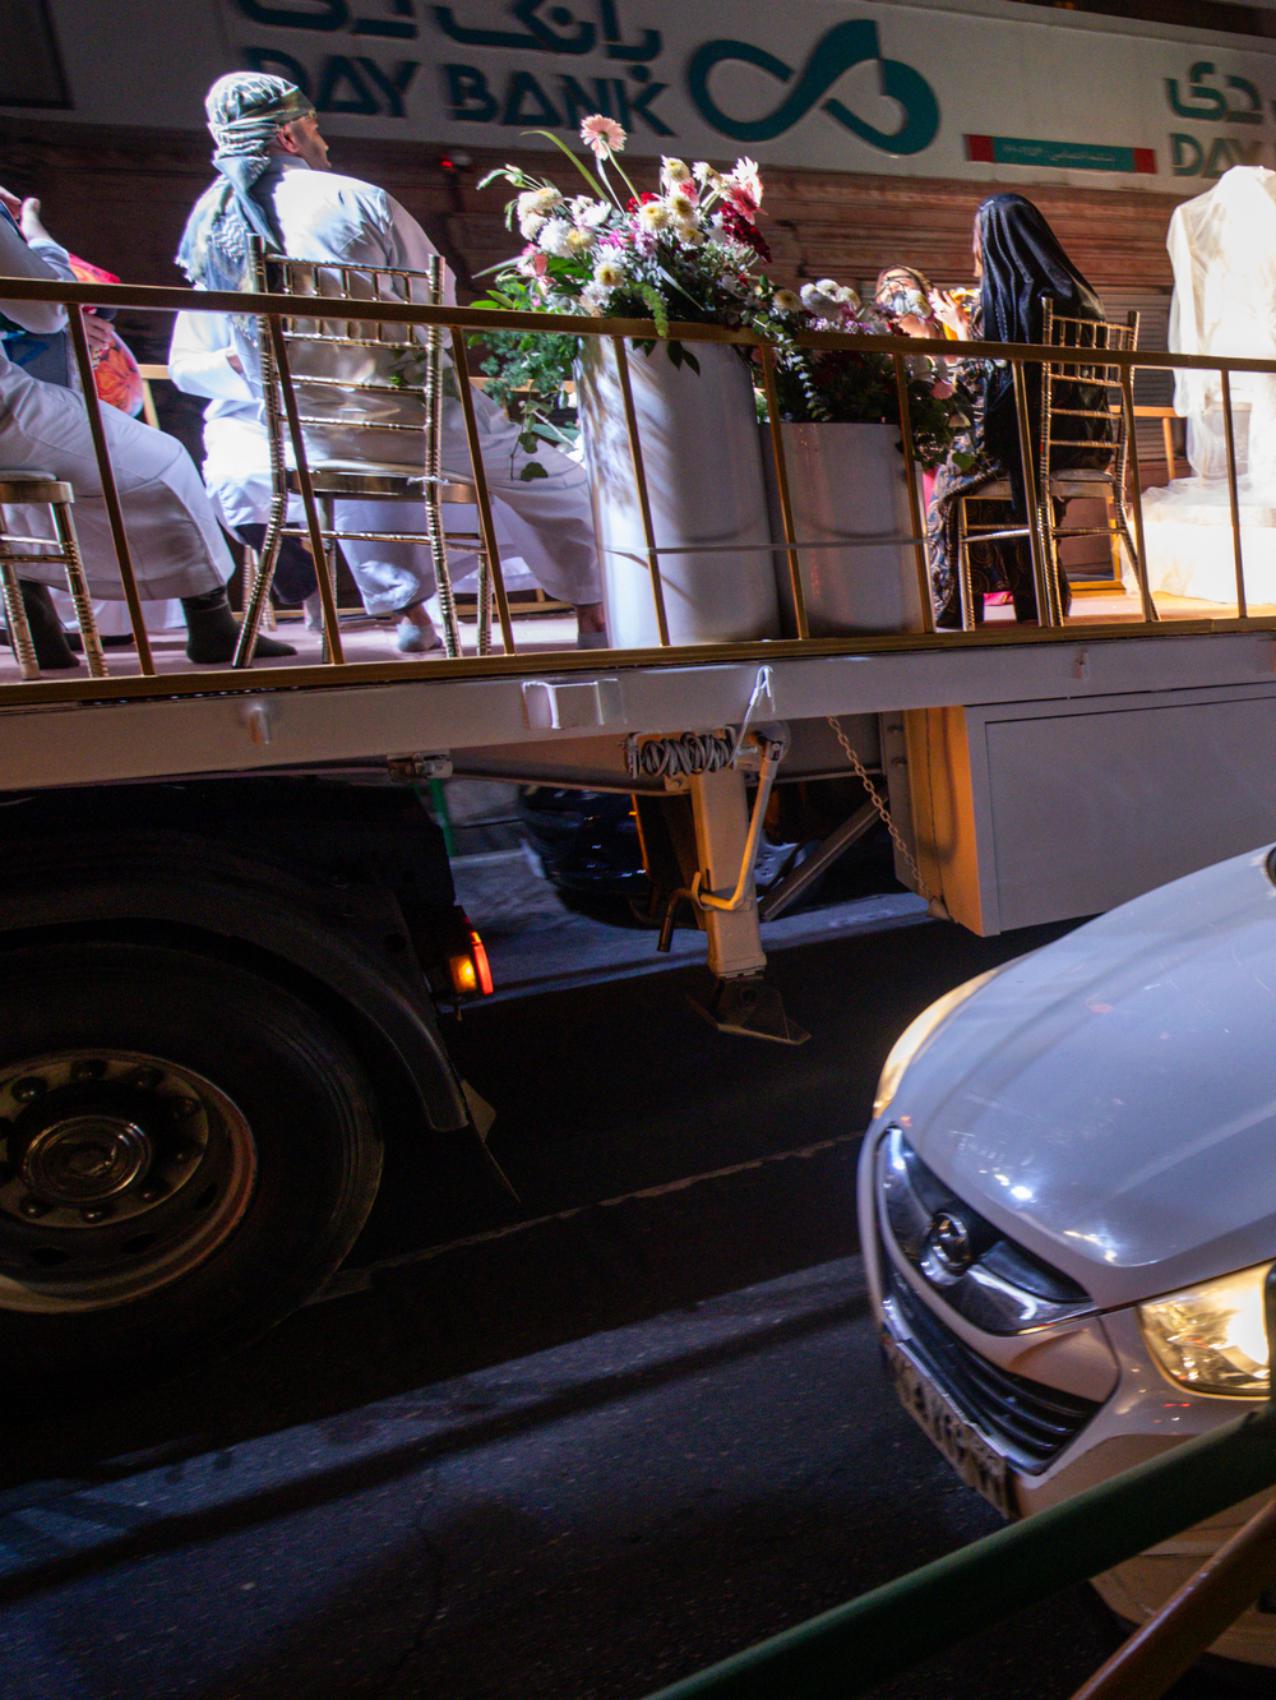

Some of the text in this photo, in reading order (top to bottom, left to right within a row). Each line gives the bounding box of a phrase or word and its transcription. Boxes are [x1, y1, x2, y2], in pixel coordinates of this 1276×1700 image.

[242, 46, 677, 136] DAY BANK
[1163, 61, 1264, 125] دی
